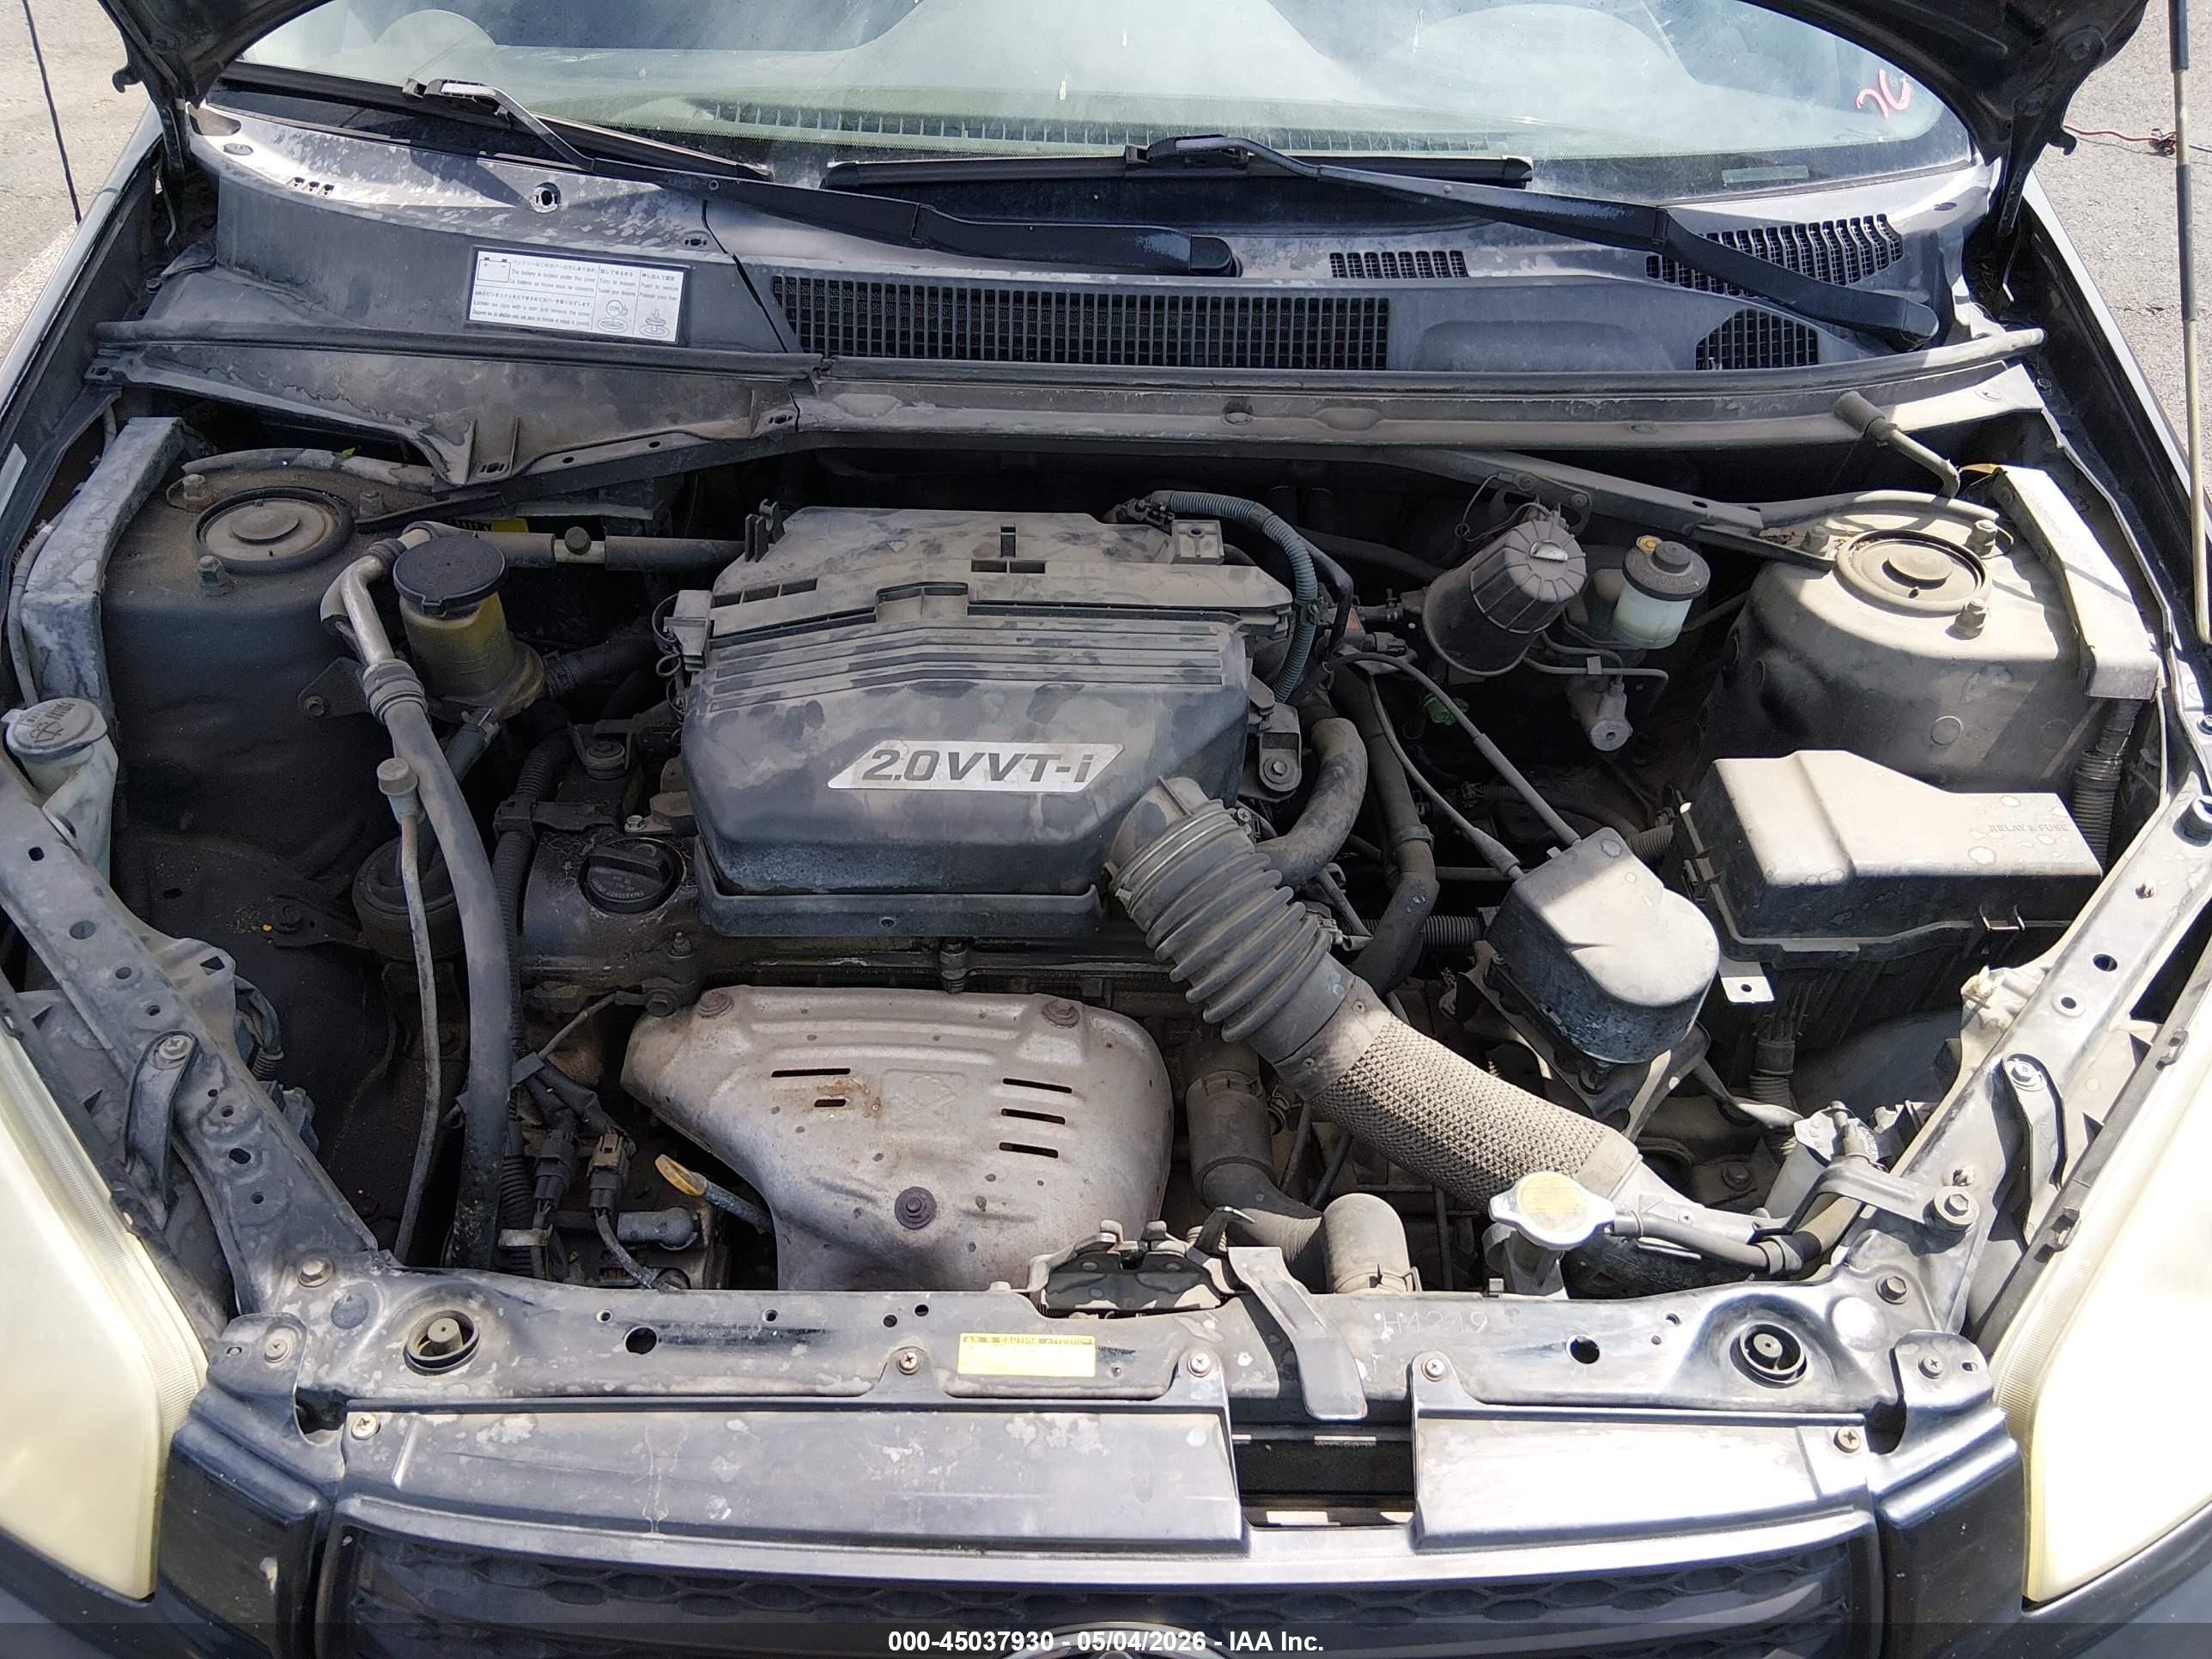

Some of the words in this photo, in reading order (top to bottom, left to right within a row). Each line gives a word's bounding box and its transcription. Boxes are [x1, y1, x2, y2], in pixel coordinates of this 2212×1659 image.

[861, 749, 940, 781] 2.0
[947, 751, 1094, 783] VVT-i
[1988, 823, 2027, 832] RELAY
[2039, 823, 2070, 832] FUSE
